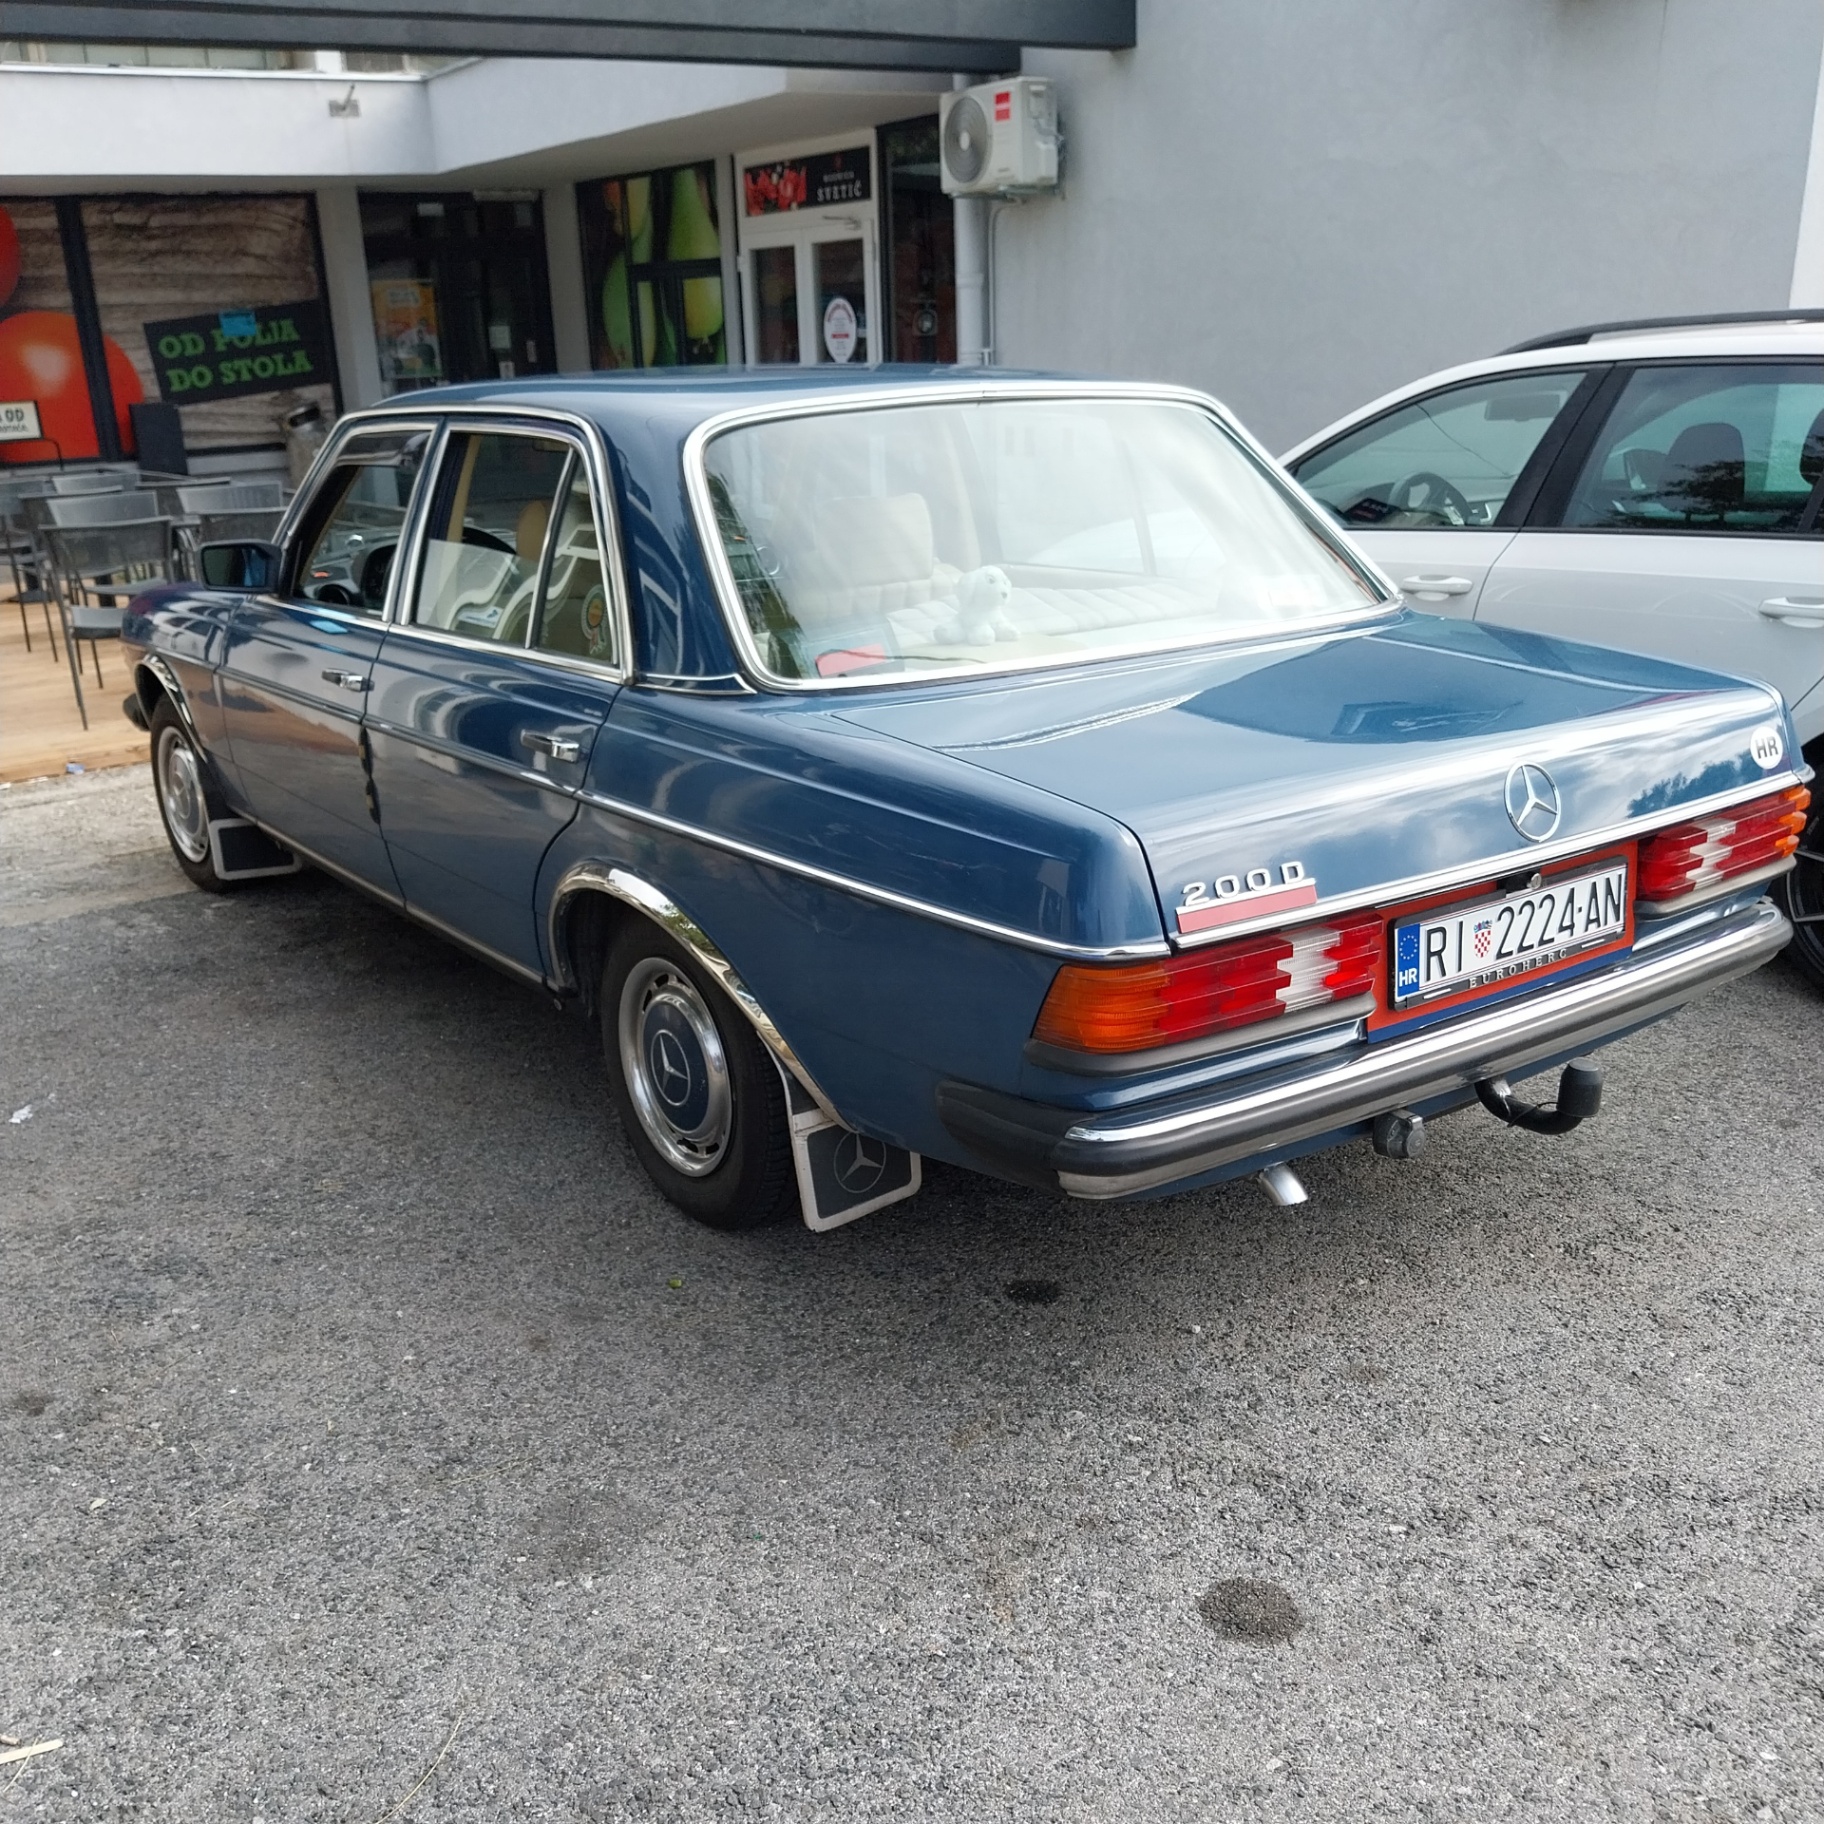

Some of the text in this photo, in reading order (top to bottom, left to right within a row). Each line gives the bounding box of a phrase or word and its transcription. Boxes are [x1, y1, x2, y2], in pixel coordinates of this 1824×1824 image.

[158, 332, 206, 359] OD
[166, 350, 314, 392] DO STOLA
[1755, 736, 1779, 759] HR
[1181, 860, 1306, 907] 200 D
[1425, 919, 1464, 982] RI
[1468, 948, 1568, 989] EUROHERC
[1398, 967, 1418, 988] HR
